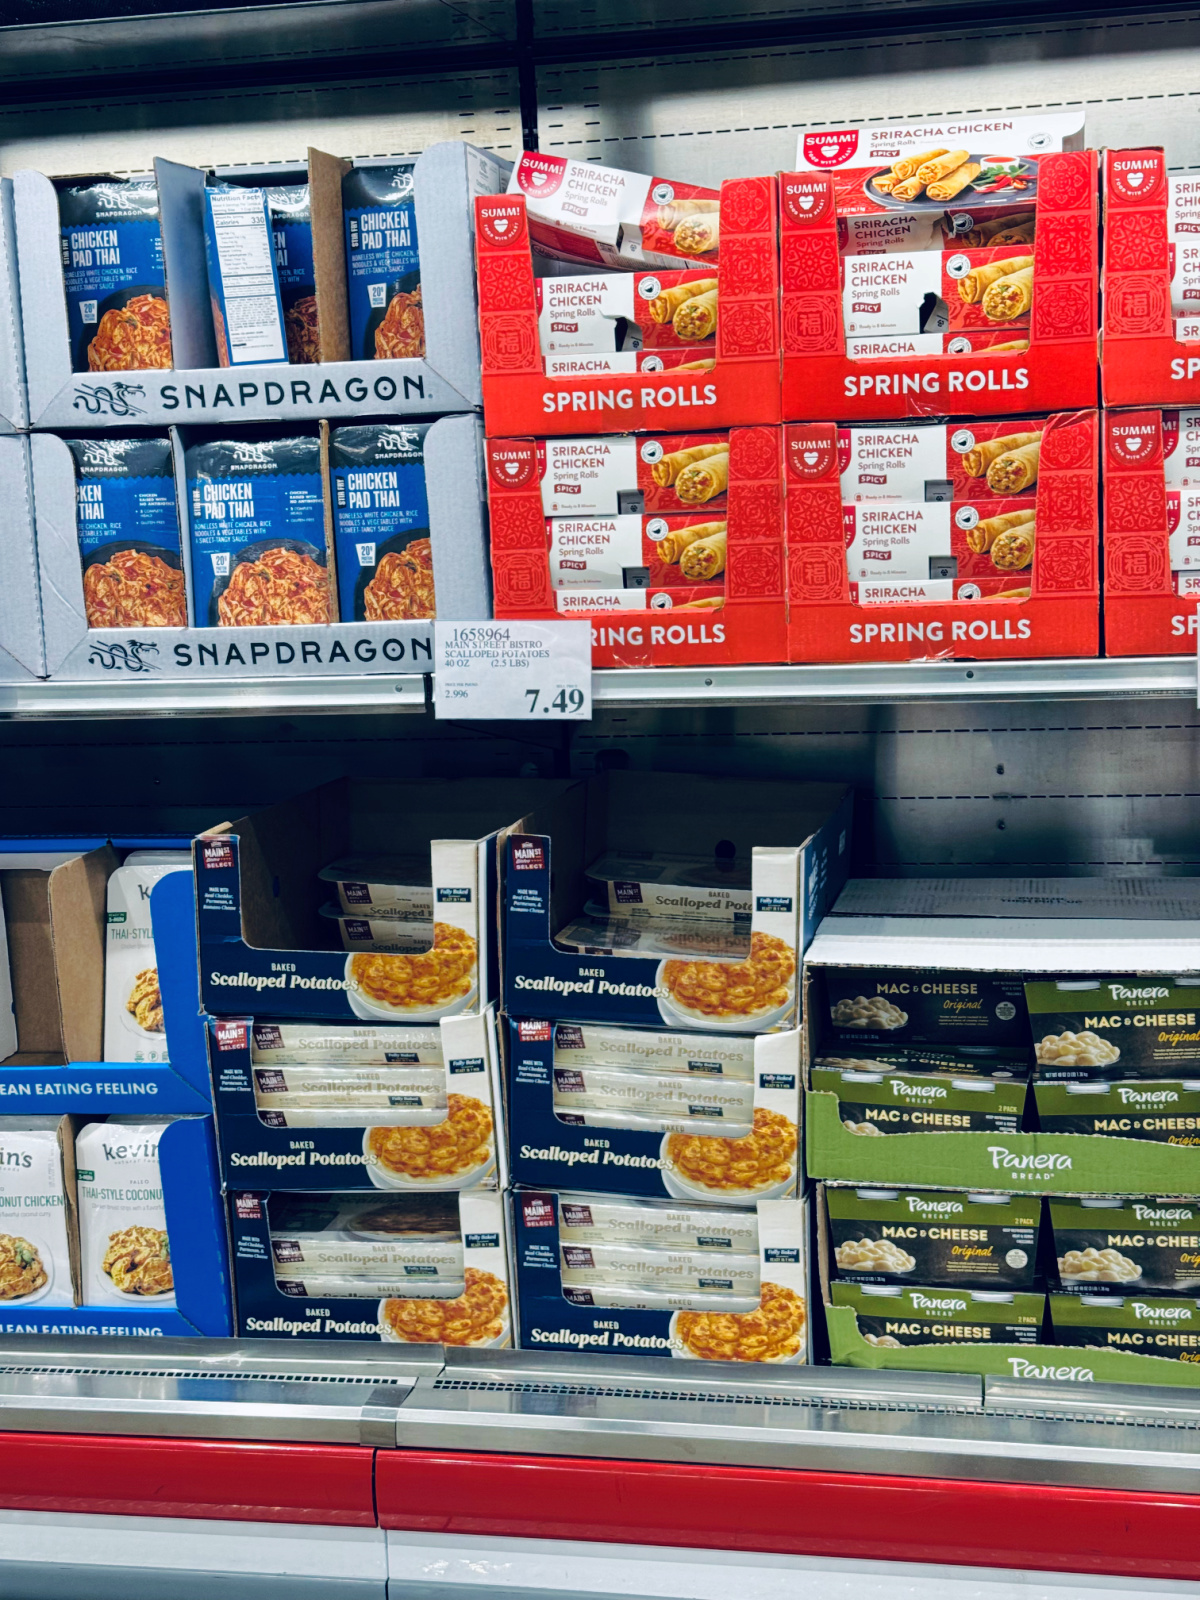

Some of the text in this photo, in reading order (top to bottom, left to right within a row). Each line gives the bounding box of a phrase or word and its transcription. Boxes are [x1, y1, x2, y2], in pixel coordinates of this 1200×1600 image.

[871, 122, 1013, 140] SRIRACHA CHICKEN
[1114, 160, 1157, 171] SUMM!
[786, 183, 826, 194] SUMM!
[481, 207, 520, 218] SUMM!
[361, 211, 408, 230] CHICKEN
[71, 230, 117, 247] CHICKEN
[362, 229, 411, 250] PAD THAI
[73, 248, 120, 266] PAD THAI
[851, 260, 914, 273] SRIRACHA
[549, 282, 608, 293] SRIRACHA
[852, 288, 899, 300] Spring Rolls
[550, 295, 601, 307] CHICKEN
[550, 308, 595, 319] Spring Rolls
[853, 343, 915, 355] SRIRACHA
[552, 361, 611, 372] SRIRACHA
[844, 369, 1029, 396] SPRING ROLLS
[160, 375, 424, 410] SNAPDRAGON
[543, 385, 717, 413] SPRING ROLLS
[552, 445, 611, 456] SRIRACHA
[791, 440, 831, 450] SUMM!
[492, 451, 531, 460] SUMM!
[348, 472, 397, 489] CHICKEN
[554, 470, 598, 481] Spring Rolls
[204, 483, 252, 500] CHICKEN
[350, 490, 400, 508] PAD THAI
[205, 501, 254, 519] PAD THAI
[558, 547, 604, 557] Spring Rolls
[453, 628, 510, 641] 1658964
[651, 624, 725, 644] ROLLS
[850, 619, 1031, 643] SPRING ROLLS
[174, 637, 432, 667] SNAPDRAGON
[445, 650, 550, 658] SCALLOPED POTATOES
[491, 659, 506, 668] (2.5
[510, 659, 529, 668] LBS)
[445, 690, 468, 698] 2.996
[525, 689, 584, 713] 7.49
[205, 849, 222, 858] MAIN
[656, 895, 720, 911] Scalloped
[370, 907, 423, 919] Scalloped
[271, 963, 296, 972] BAKED
[579, 968, 604, 977] BAKED
[211, 972, 358, 991] Scalloped Potatoes
[515, 975, 669, 998] Scalloped Potatoes
[877, 983, 909, 994] MAC
[921, 984, 978, 994] CHEESE
[1108, 985, 1169, 1000] Panera
[944, 999, 983, 1014] Original
[1085, 1016, 1121, 1028] MAC
[1133, 1014, 1196, 1027] CHEESE
[36, 1084, 158, 1095] EATING FEELING
[890, 1080, 947, 1098] Panera
[1117, 1088, 1178, 1103] Panera
[866, 1109, 900, 1122] MAC
[911, 1114, 970, 1127] CHEESE
[290, 1141, 314, 1149] BAKED
[584, 1139, 610, 1148] BAKED
[231, 1152, 378, 1169] Scalloped Potatoes
[520, 1145, 673, 1170] Scalloped Potatoes
[987, 1146, 1072, 1170] Panera
[82, 1187, 123, 1200] THAI-STYLE
[1108, 1235, 1144, 1246] MAC
[952, 1246, 993, 1259] Original
[246, 1318, 391, 1335] Scalloped Potatoes
[1107, 1333, 1143, 1344] MAC
[1008, 1357, 1094, 1381] Panera
